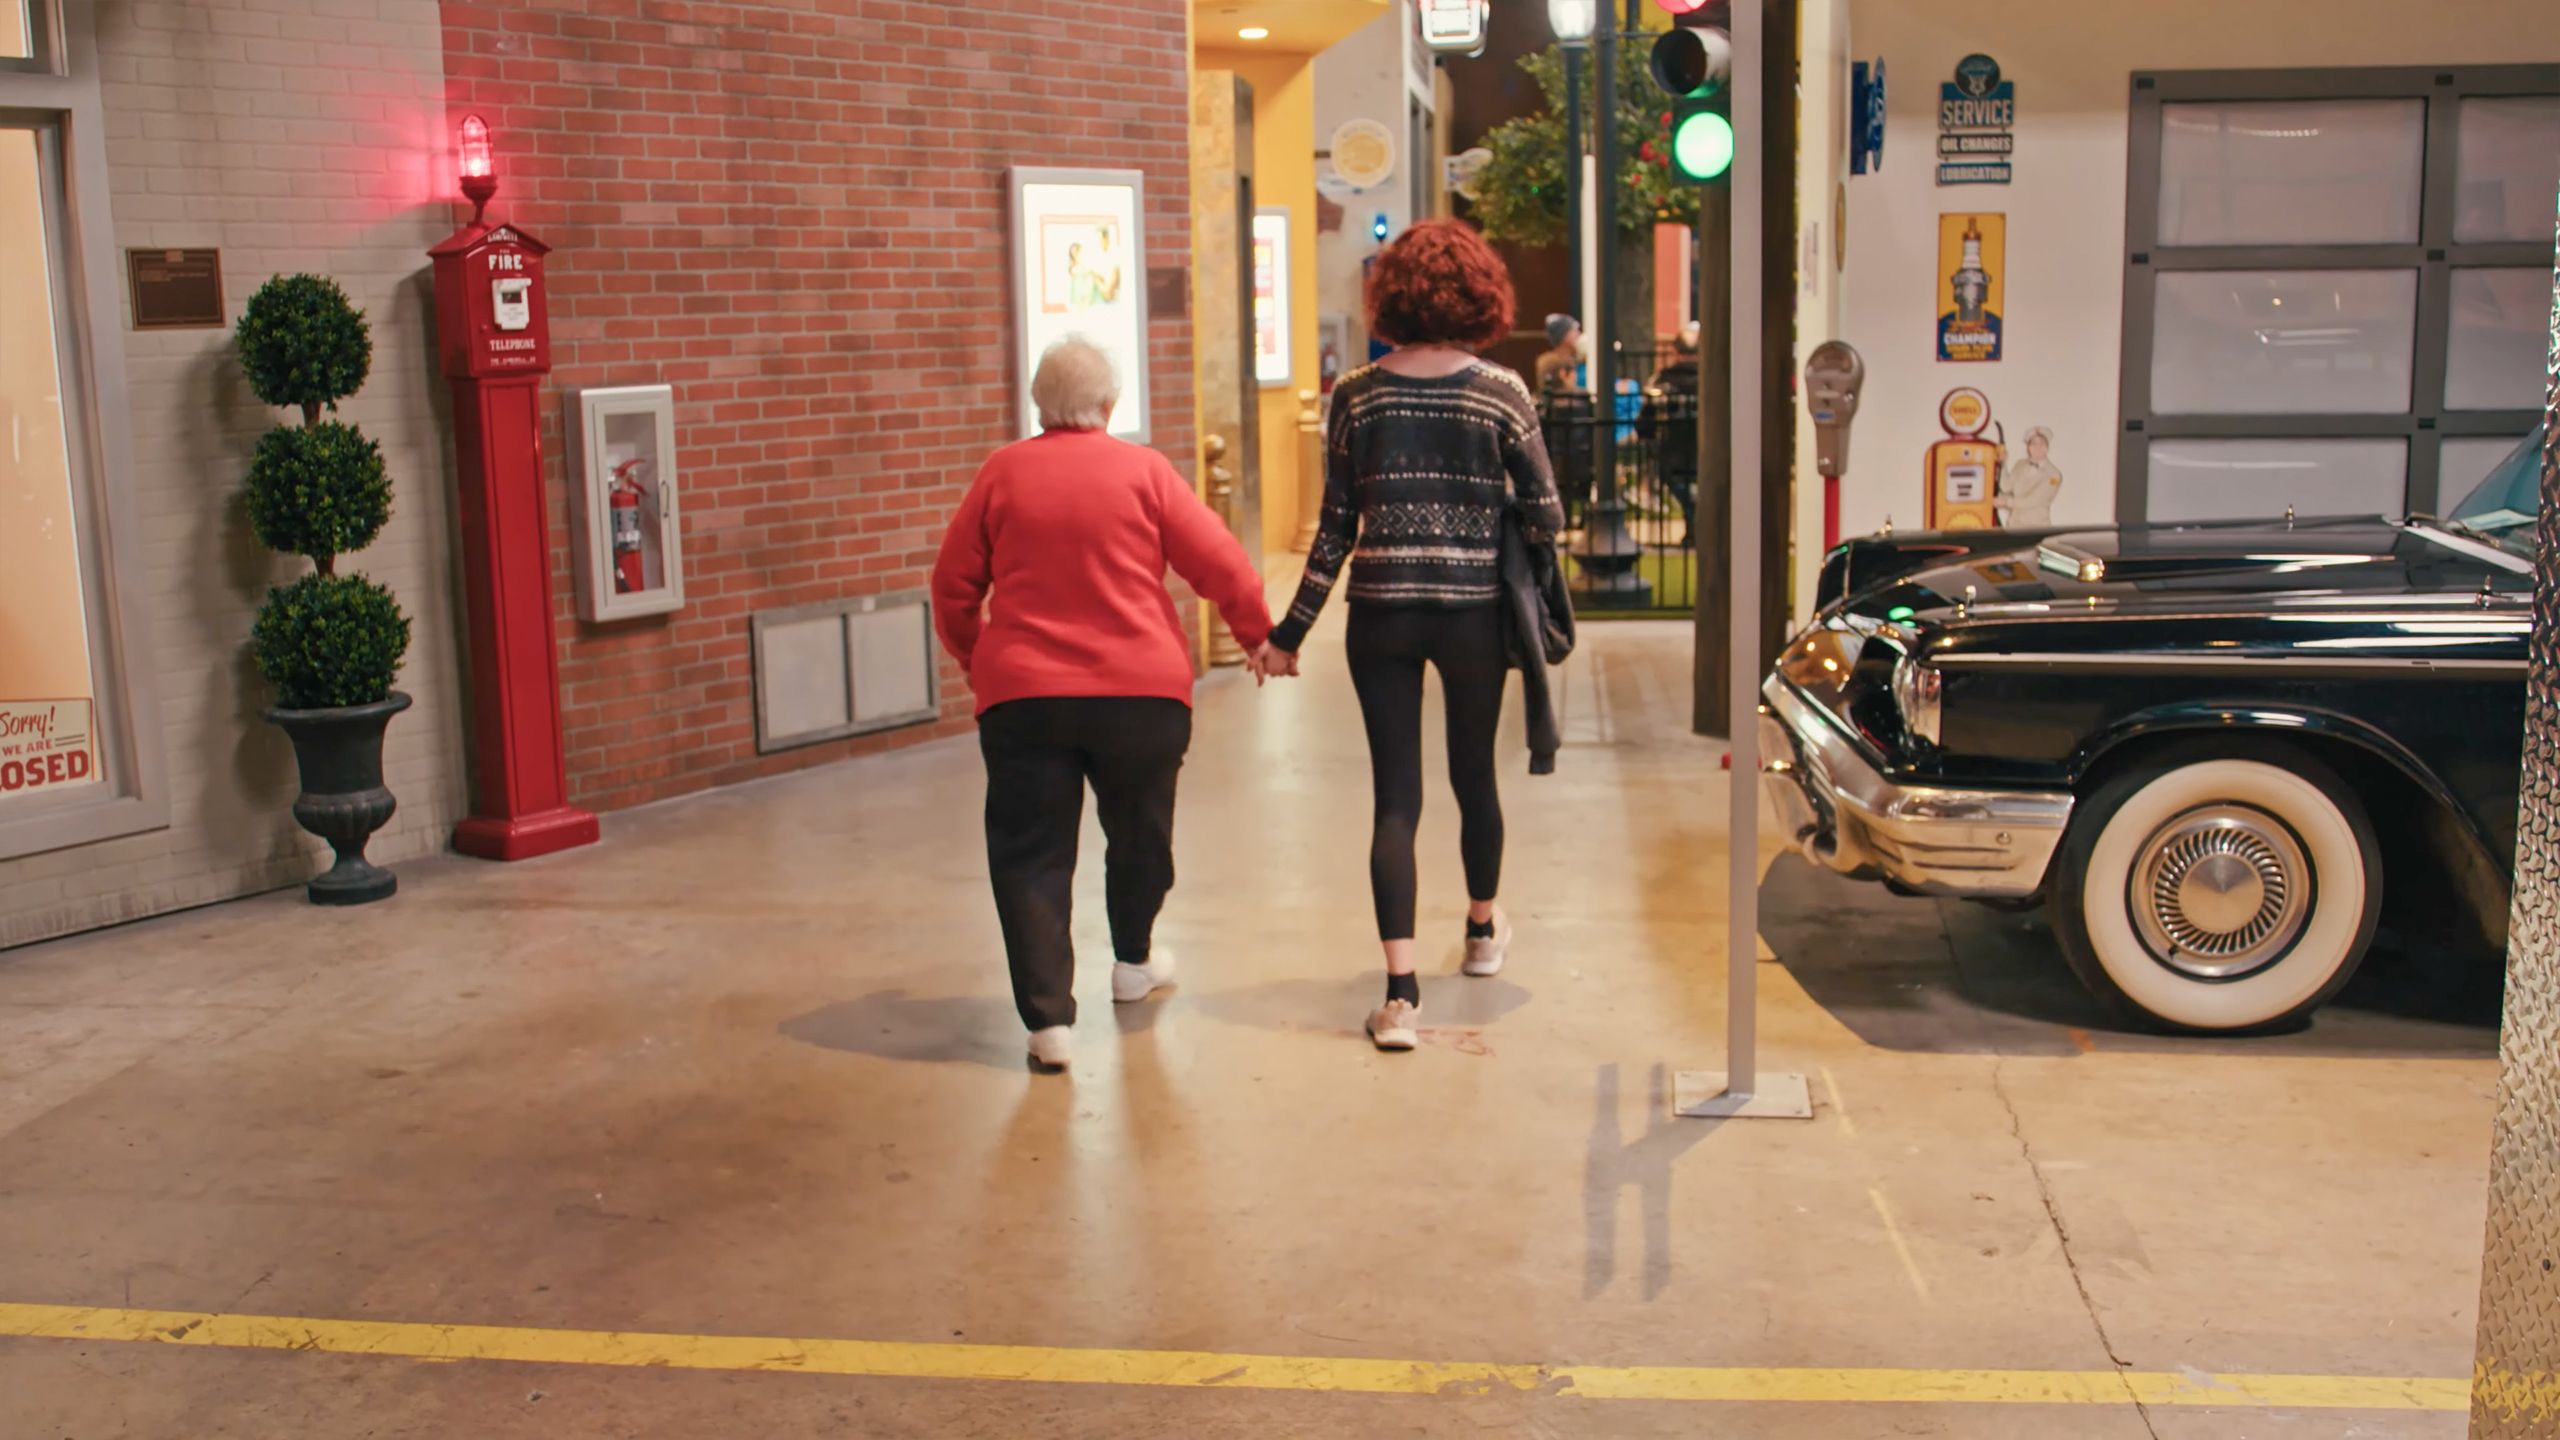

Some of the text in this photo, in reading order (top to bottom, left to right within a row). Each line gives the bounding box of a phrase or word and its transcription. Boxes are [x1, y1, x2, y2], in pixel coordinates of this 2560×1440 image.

[1941, 99, 2011, 126] SERVICE
[1941, 136, 2010, 152] OIL CHANGES
[1941, 166, 2009, 181] LUBRICATION
[488, 254, 523, 271] FIRE
[489, 338, 536, 351] TELEPHONE
[1944, 332, 1996, 345] CHAMPION
[0, 705, 55, 739] Sorry!
[2, 739, 53, 757] WE ARE
[0, 749, 89, 792] OSED
